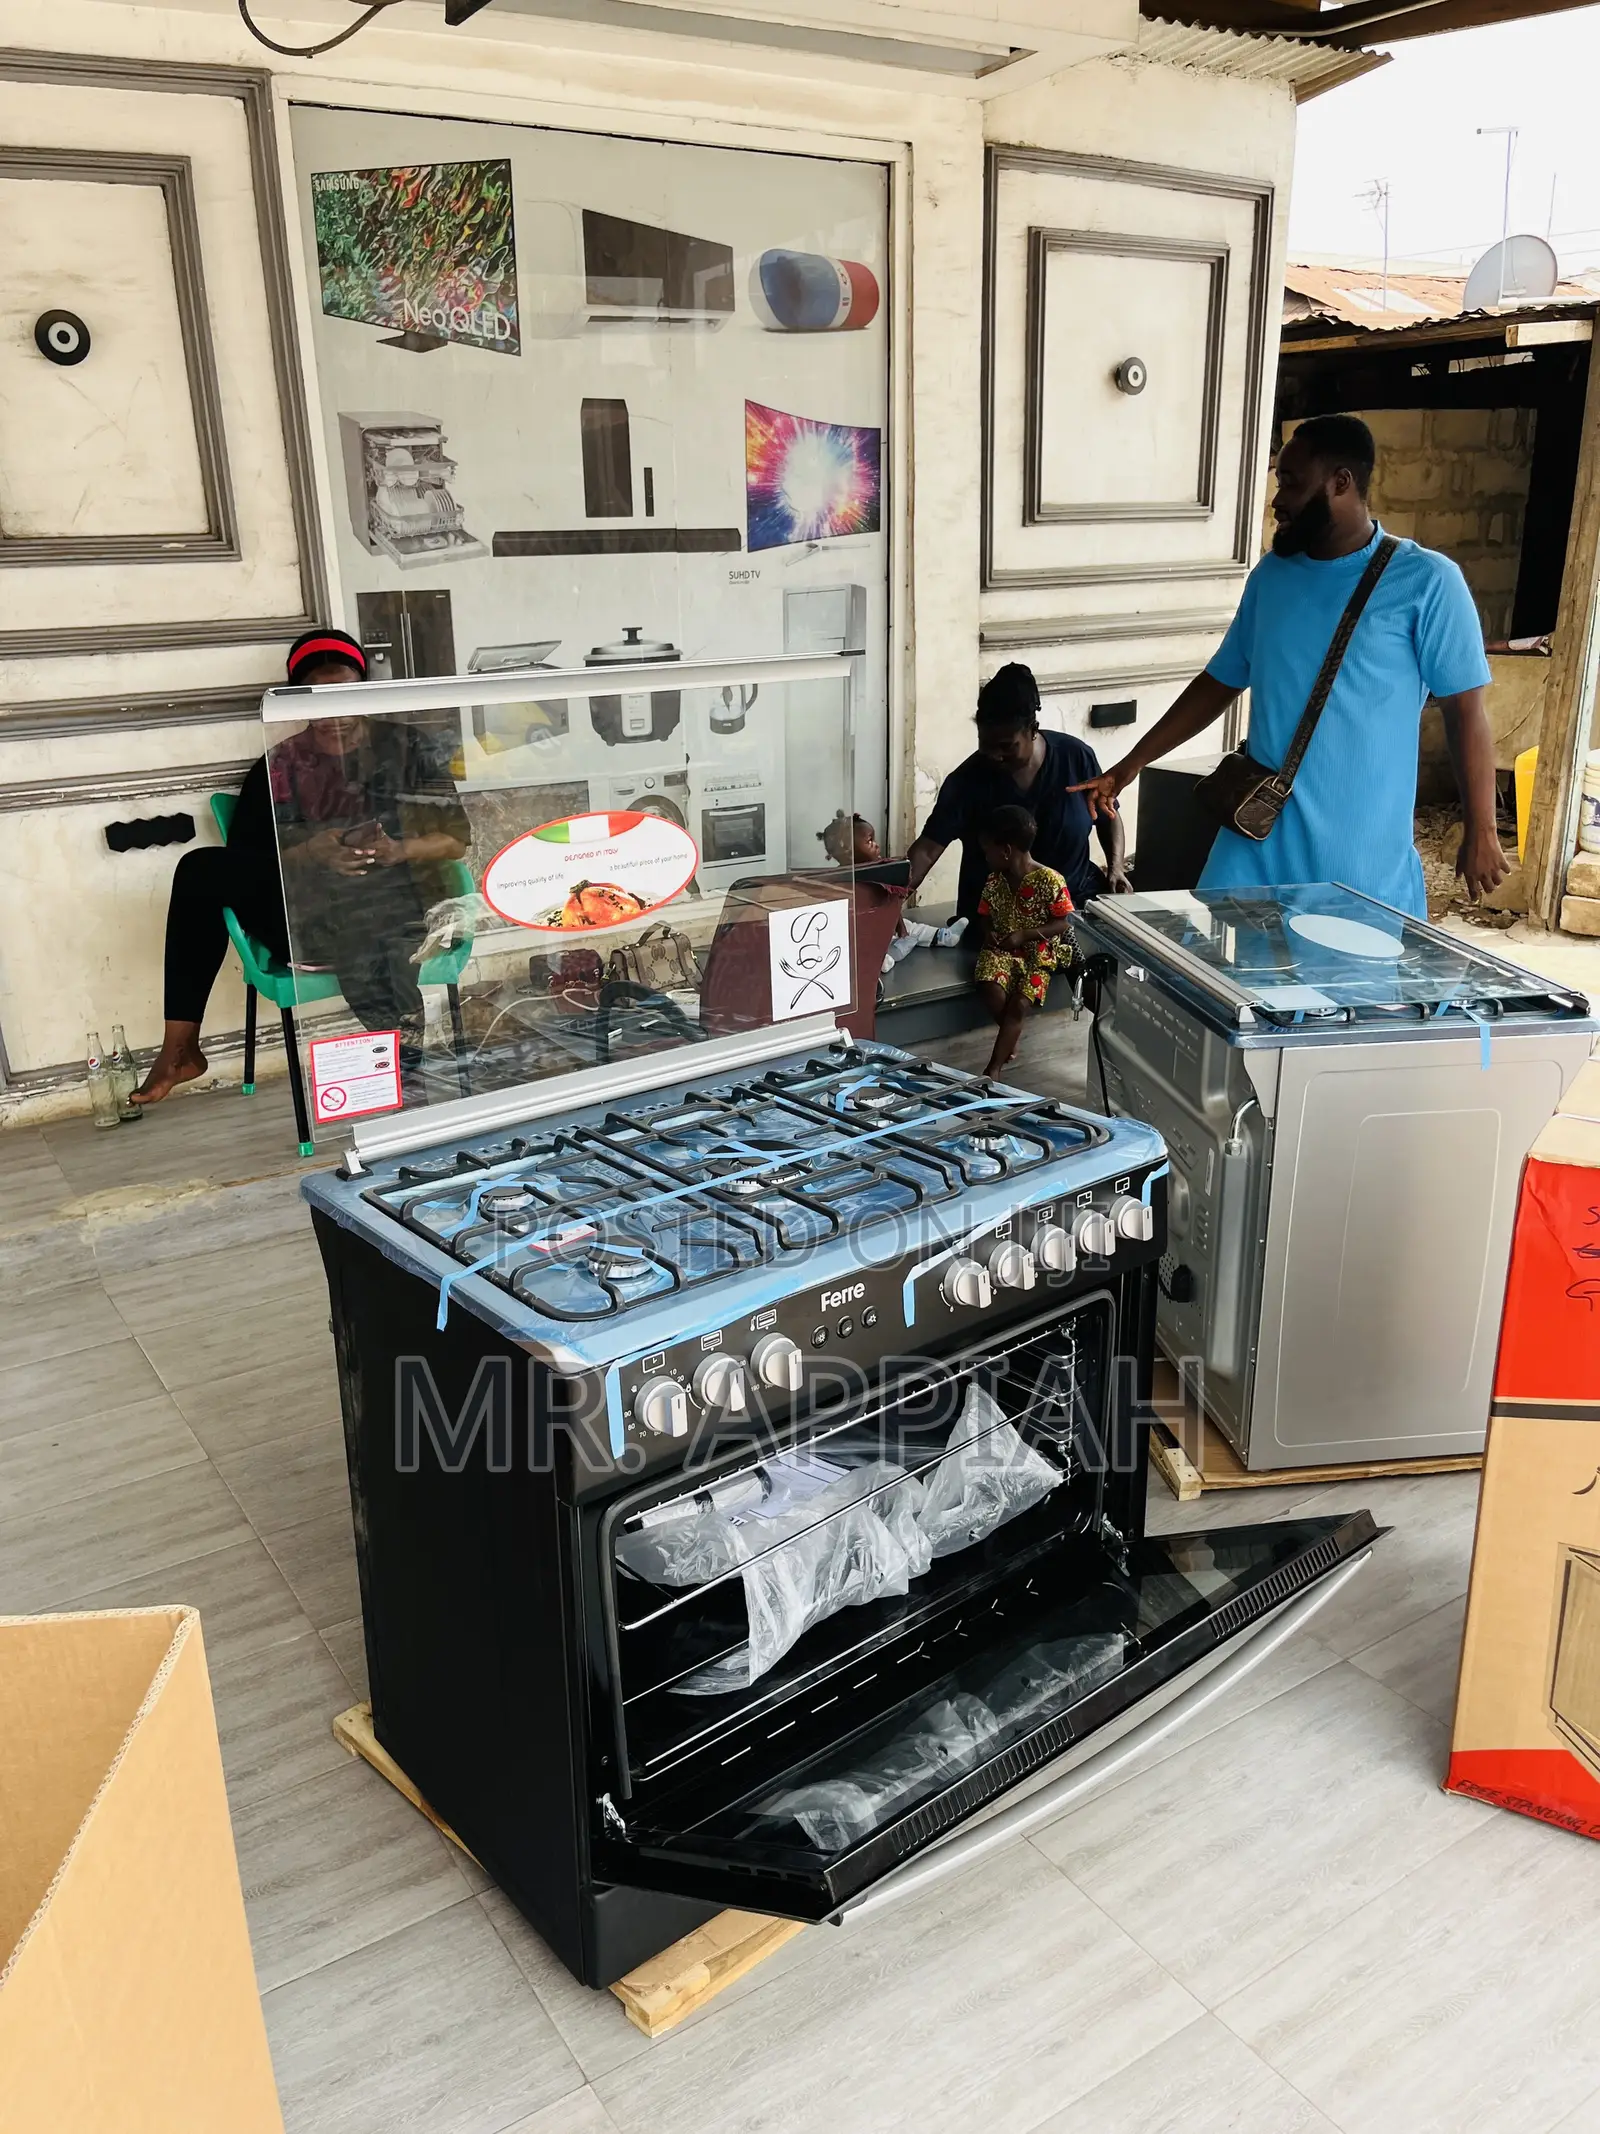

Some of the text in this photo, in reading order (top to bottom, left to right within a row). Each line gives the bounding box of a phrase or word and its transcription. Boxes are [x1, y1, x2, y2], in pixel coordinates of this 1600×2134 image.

[314, 178, 359, 192] SAMSUNG
[403, 298, 510, 340] Neo QLED
[728, 570, 761, 580] SUHD TV
[564, 851, 594, 862] DESIGNED
[820, 1282, 866, 1313] Ferre
[669, 1368, 677, 1376] 10
[677, 1375, 685, 1383] 20
[624, 1410, 632, 1418] 90
[639, 1430, 647, 1438] 70
[1456, 1779, 1588, 1832] FREE STANDING
